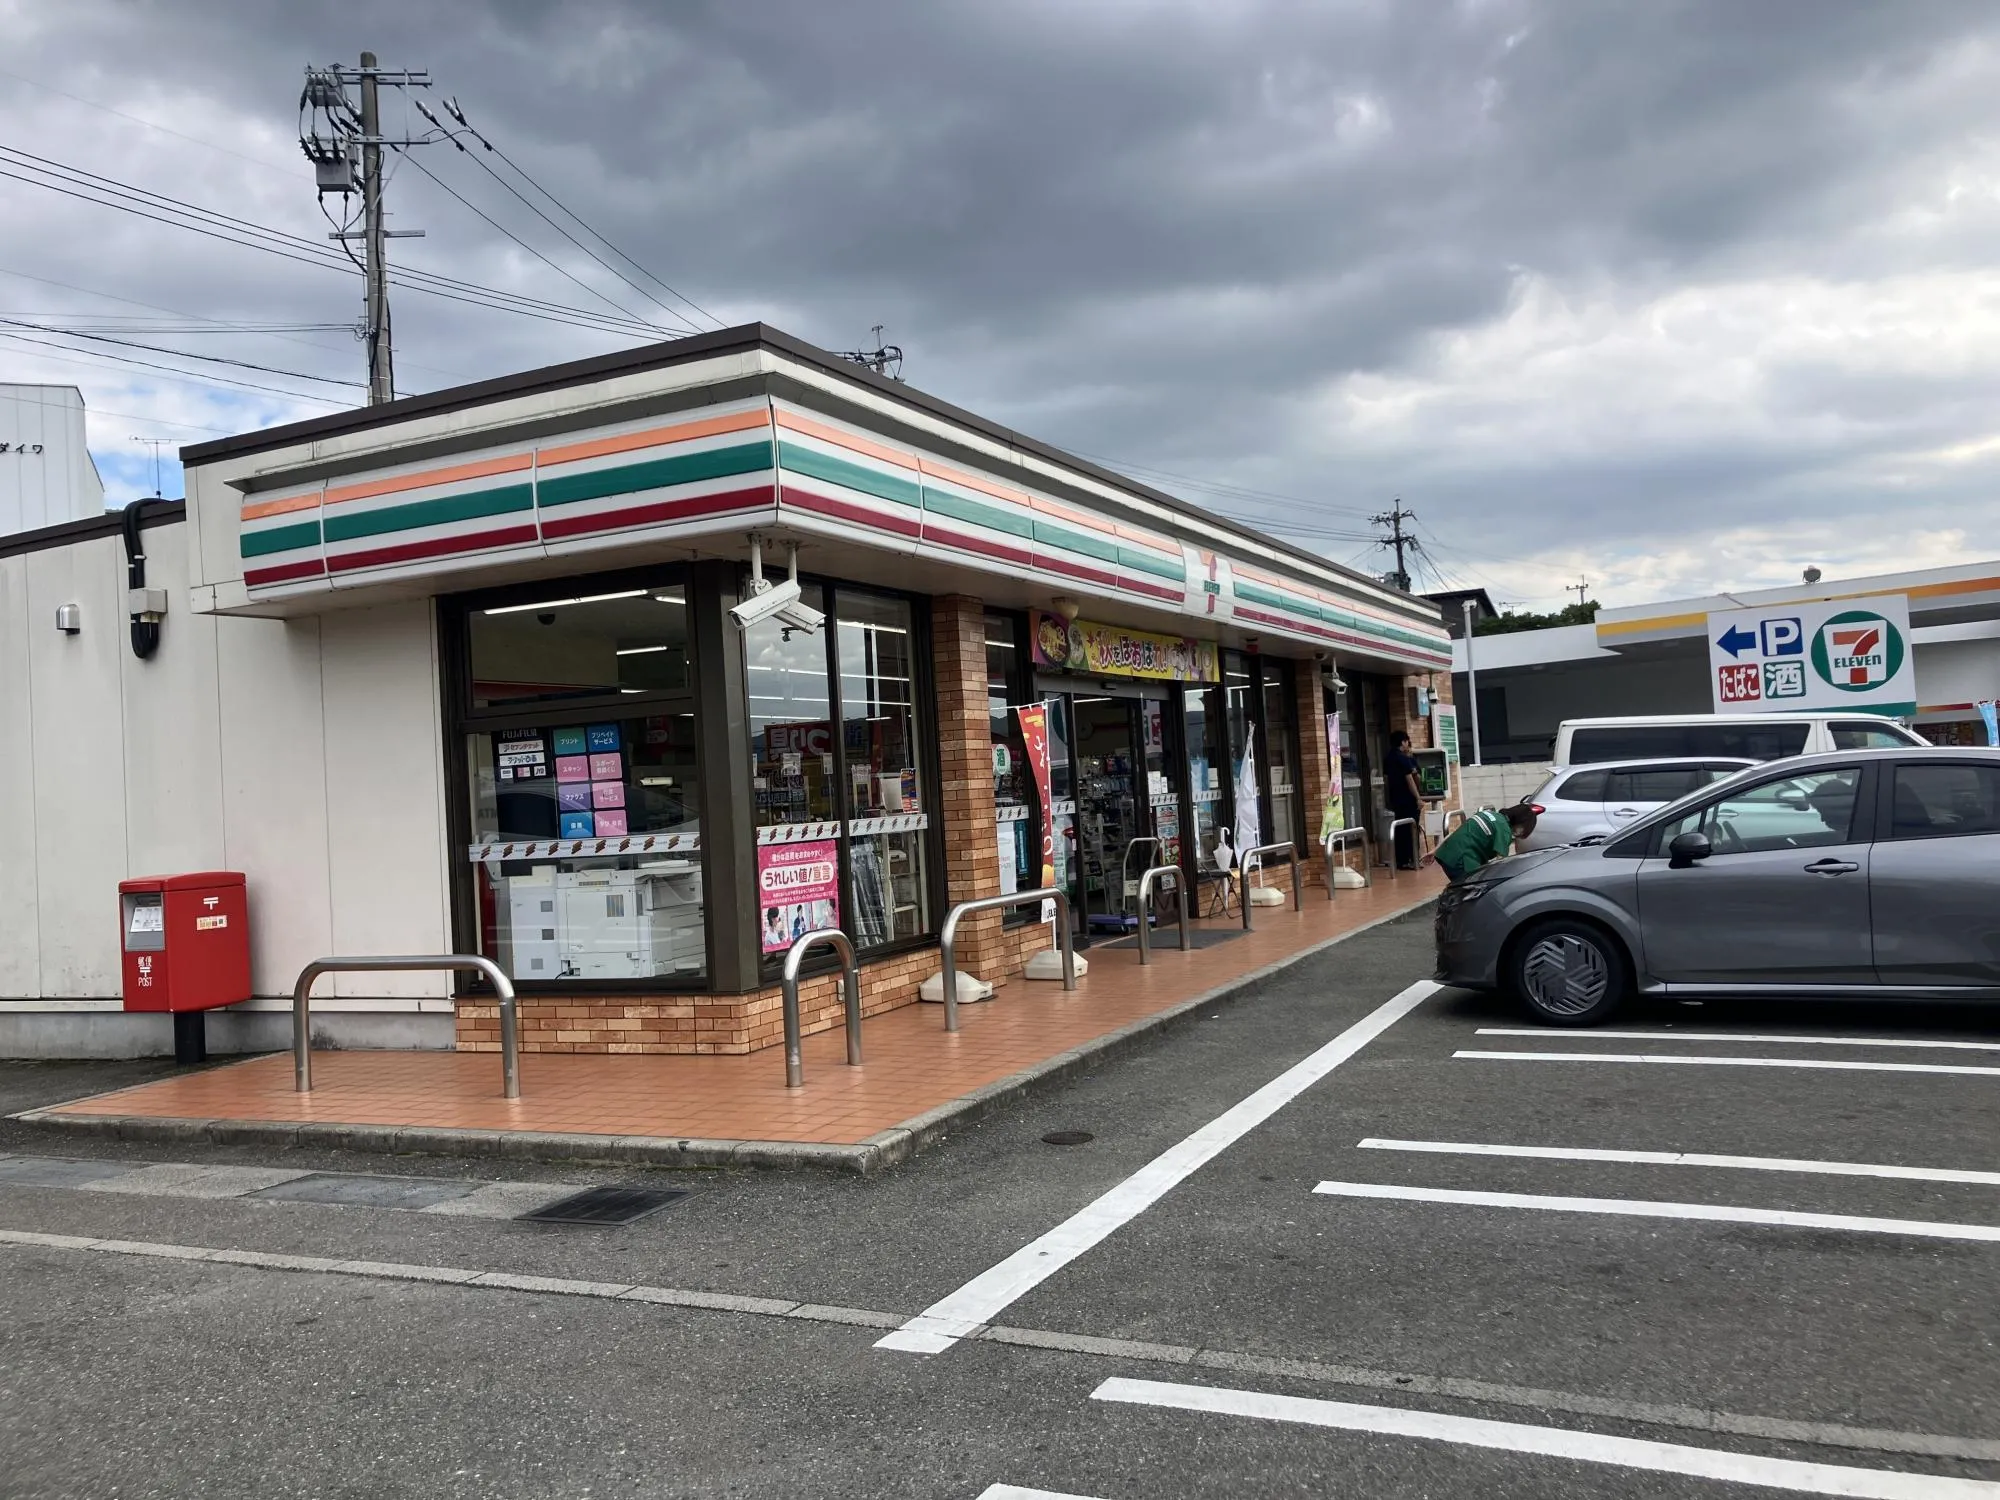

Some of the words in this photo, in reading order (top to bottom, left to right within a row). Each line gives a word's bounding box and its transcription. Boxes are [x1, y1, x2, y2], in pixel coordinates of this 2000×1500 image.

[1765, 619, 1800, 656] P
[1832, 628, 1880, 685] 7
[1720, 667, 1760, 699] たばこ
[1765, 662, 1803, 697] 酒
[562, 765, 582, 773] スキャン
[137, 956, 152, 968] 郵便
[138, 977, 153, 987] POST
